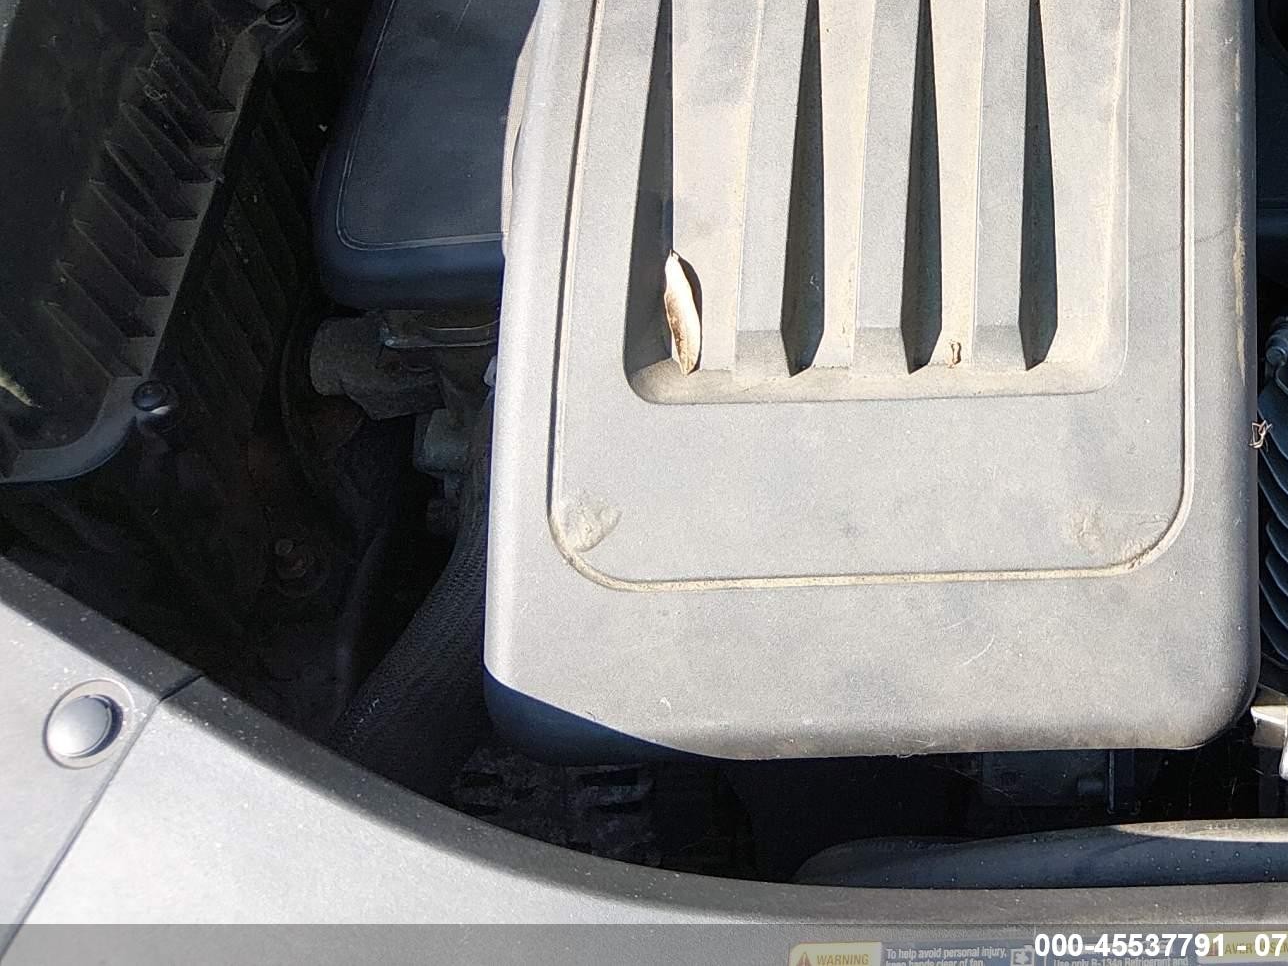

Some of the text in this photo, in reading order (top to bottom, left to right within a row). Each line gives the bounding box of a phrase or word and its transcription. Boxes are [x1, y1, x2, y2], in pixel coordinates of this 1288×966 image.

[816, 953, 869, 966] WARNING
[886, 946, 1007, 960] To help avoid personal injury,
